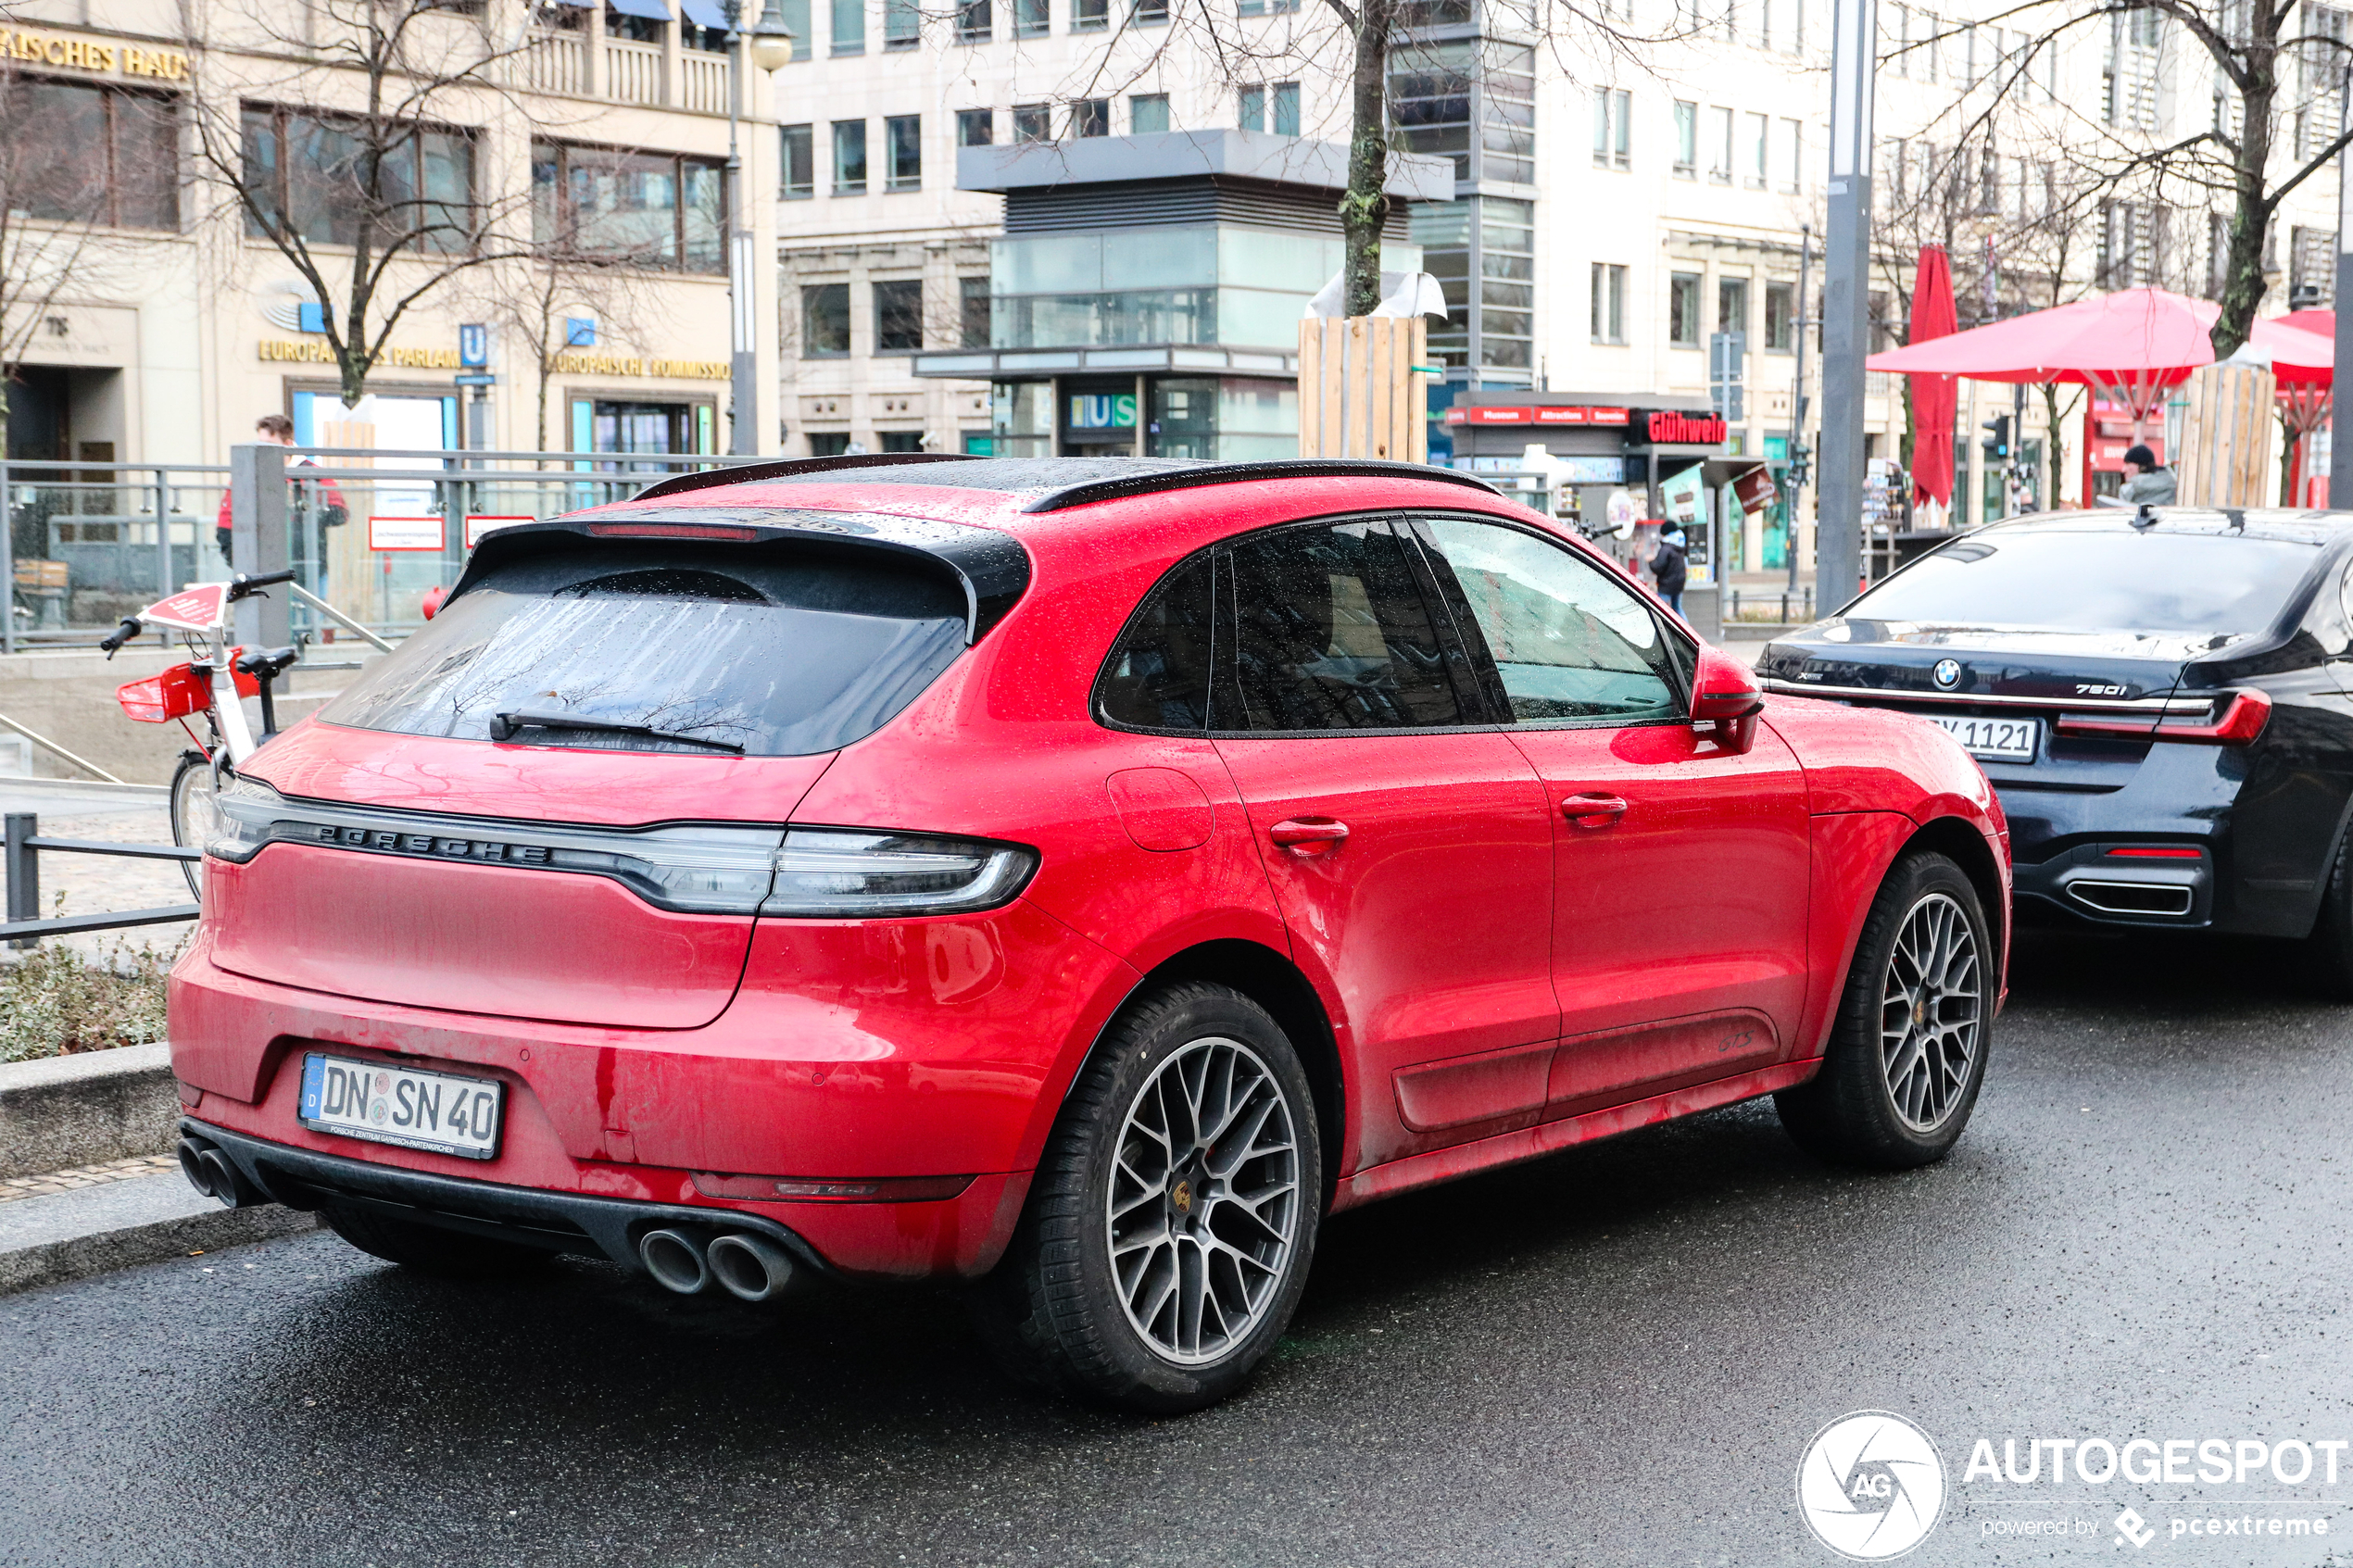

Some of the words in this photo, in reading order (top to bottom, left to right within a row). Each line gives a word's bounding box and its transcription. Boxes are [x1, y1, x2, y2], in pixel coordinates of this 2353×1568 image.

[465, 328, 485, 362] U
[652, 358, 733, 381] KOMMISSIO
[1540, 409, 1583, 420] Attractions
[1648, 410, 1727, 443] Glühwein
[1963, 721, 2030, 752] 1121
[318, 825, 551, 865] PORSCHE
[1718, 1029, 1755, 1053] GTS
[308, 1094, 317, 1108] D
[323, 1066, 371, 1120] DN
[392, 1078, 442, 1132] SN
[447, 1087, 495, 1141] 40
[330, 1125, 356, 1137] PORSCHE
[355, 1129, 381, 1141] ZENTRUM
[381, 1133, 455, 1154] GARMISCH-PARTENKIRCHEN
